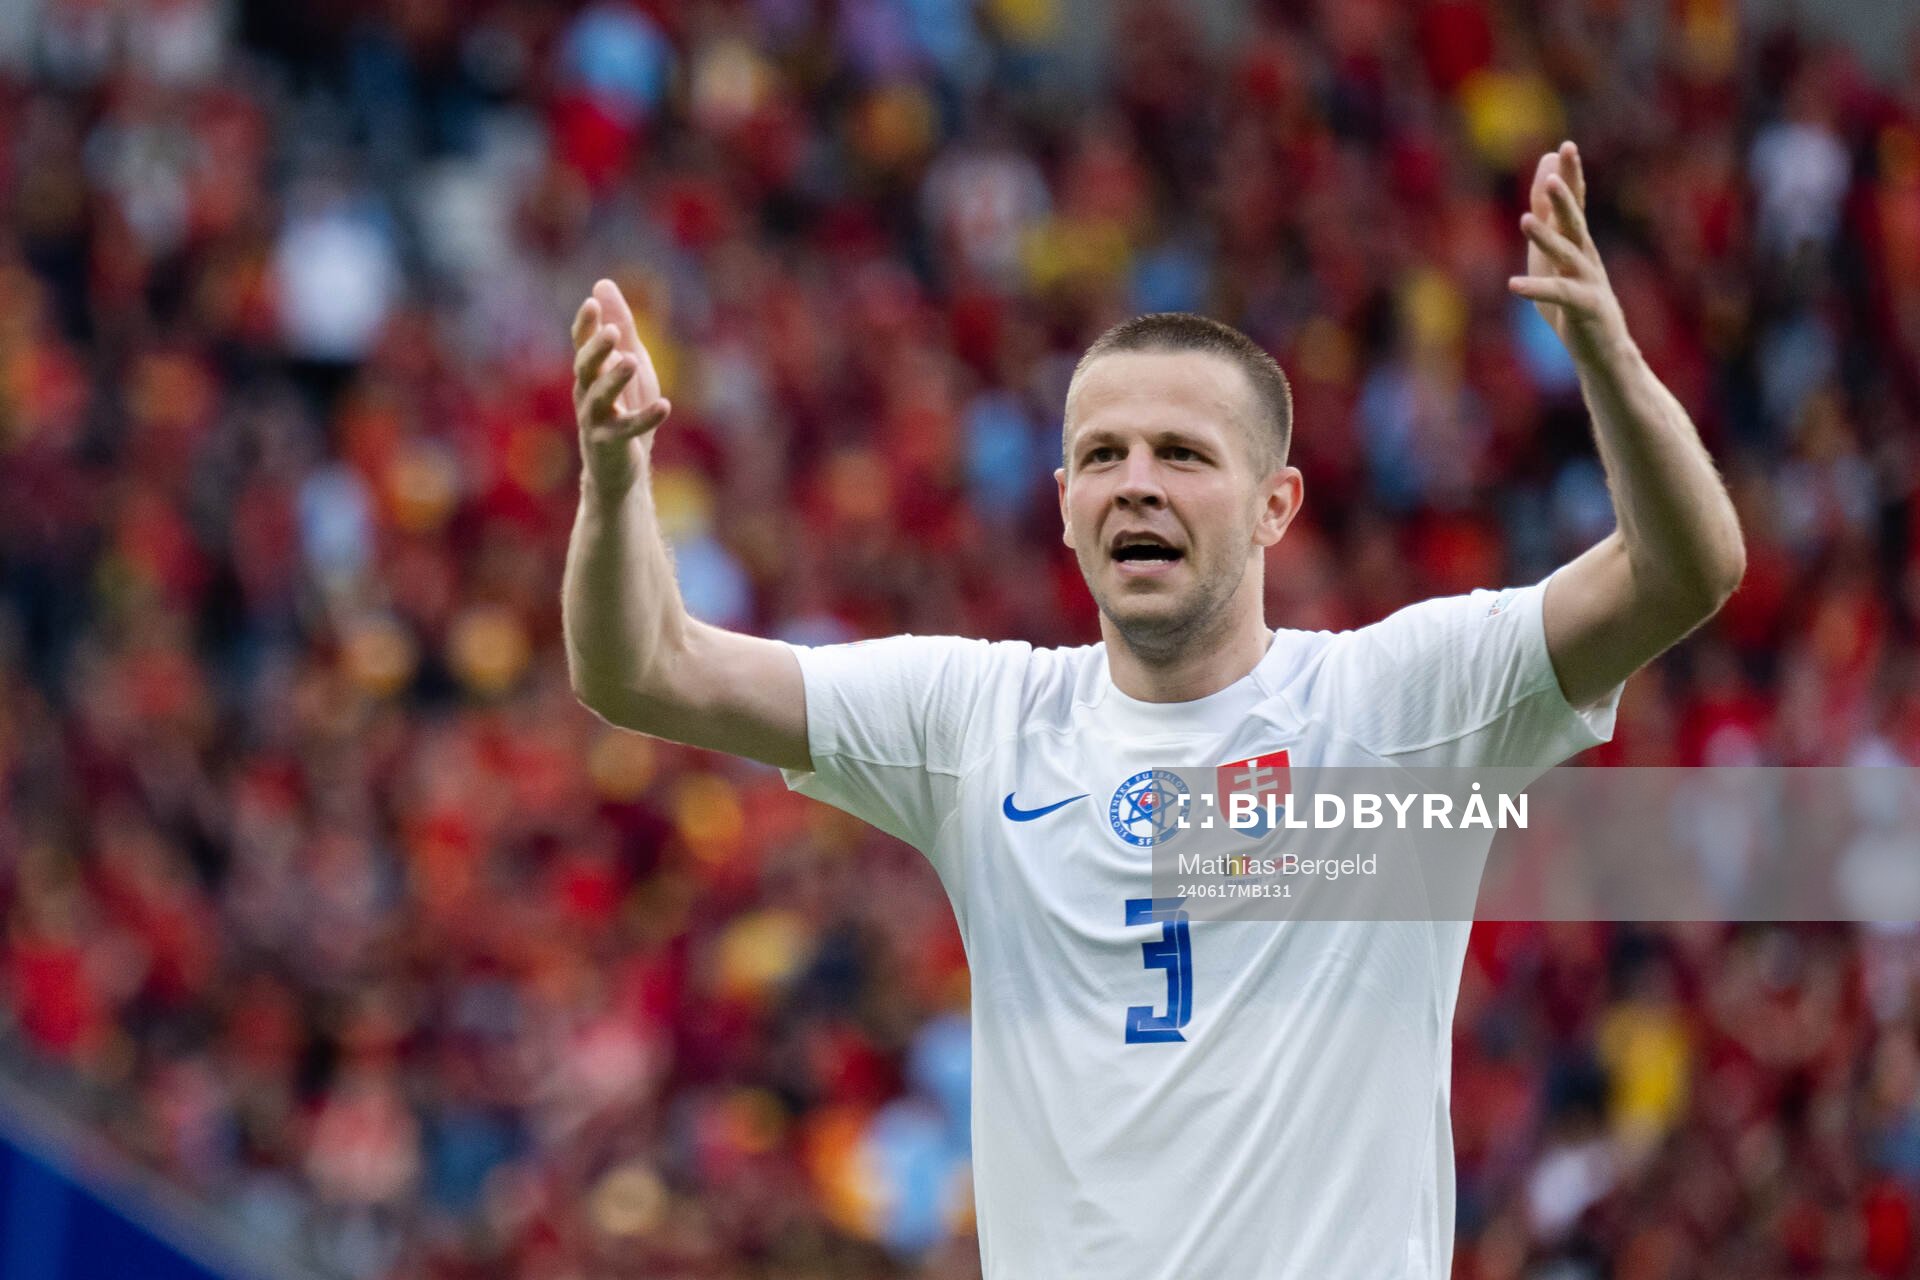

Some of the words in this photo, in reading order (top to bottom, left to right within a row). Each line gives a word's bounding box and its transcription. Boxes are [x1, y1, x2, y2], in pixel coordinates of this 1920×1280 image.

[1135, 771, 1188, 800] FUTBALOV
[1137, 836, 1160, 846] SFZ
[1124, 897, 1193, 1045] 3
